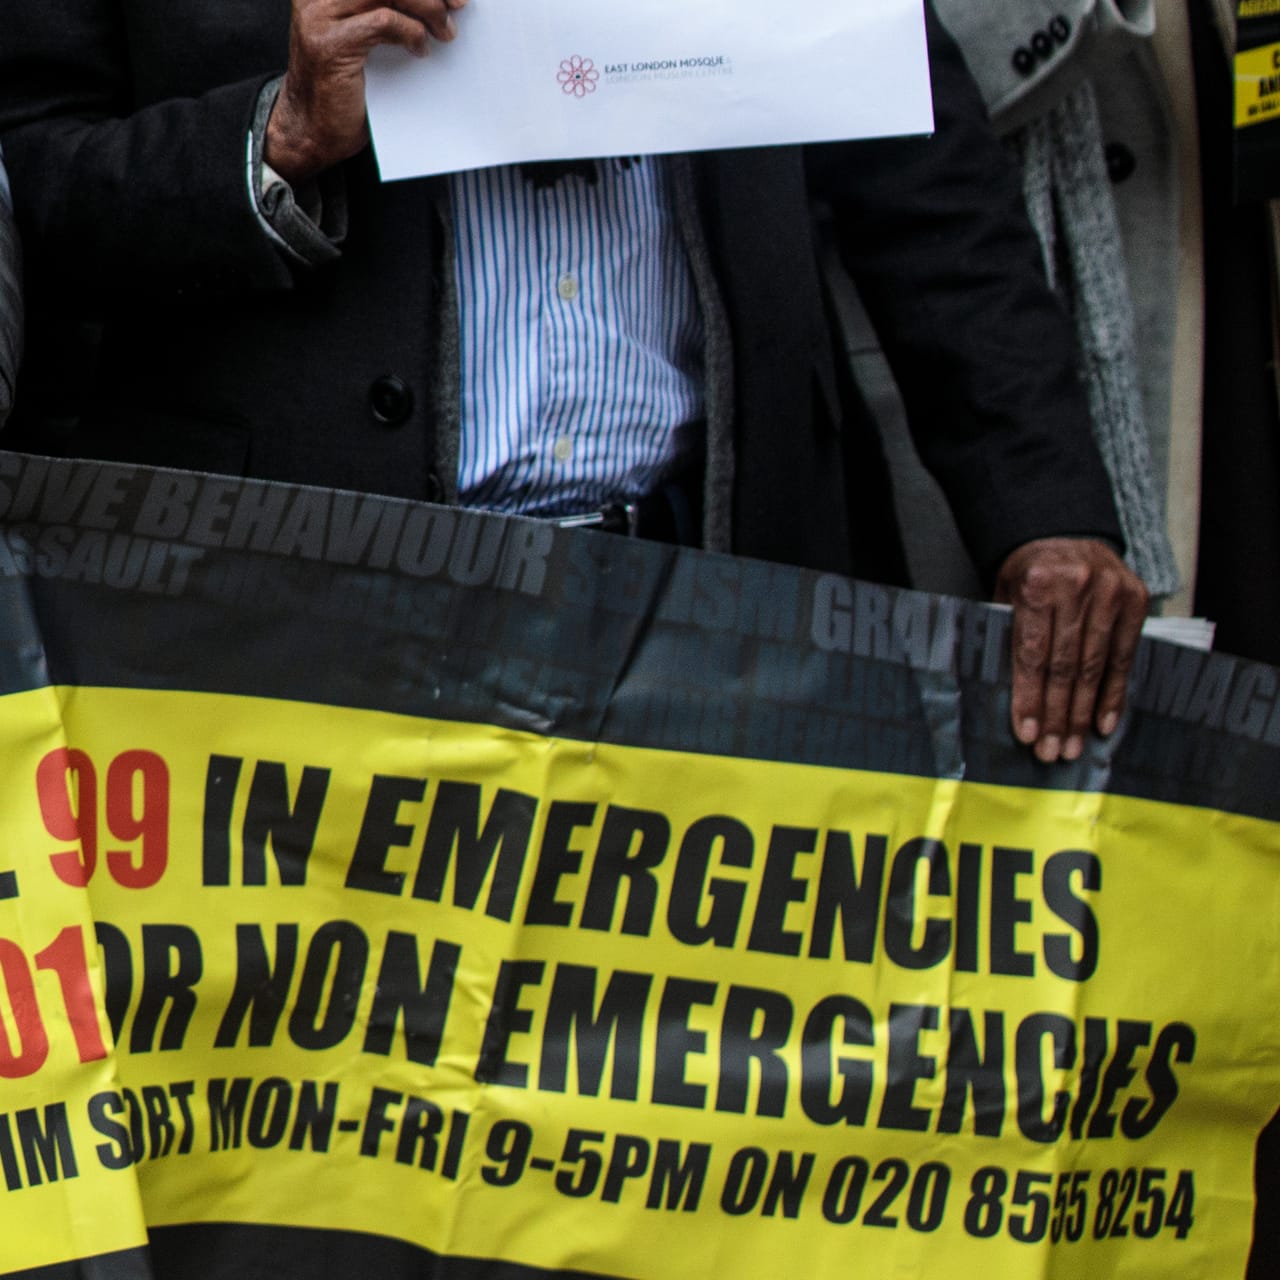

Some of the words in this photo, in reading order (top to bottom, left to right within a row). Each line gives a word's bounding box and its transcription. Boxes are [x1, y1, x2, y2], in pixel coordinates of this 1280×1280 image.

[605, 64, 629, 74] EAST
[631, 60, 677, 72] LONDON
[679, 55, 725, 69] MOSQUE
[133, 466, 552, 596] BEHAVIOUR
[35, 747, 171, 890] 99
[203, 754, 331, 887] IN
[345, 773, 1103, 982] EMERGENCIES
[214, 919, 463, 1067] NON
[476, 958, 1196, 1144] EMERGENCIES
[208, 1075, 471, 1181] MON-FRI
[480, 1119, 712, 1212] 9-5PM
[719, 1145, 815, 1221] ON
[821, 1154, 950, 1233] 020
[963, 1164, 1091, 1244] 8555
[1094, 1168, 1197, 1242] 8254
